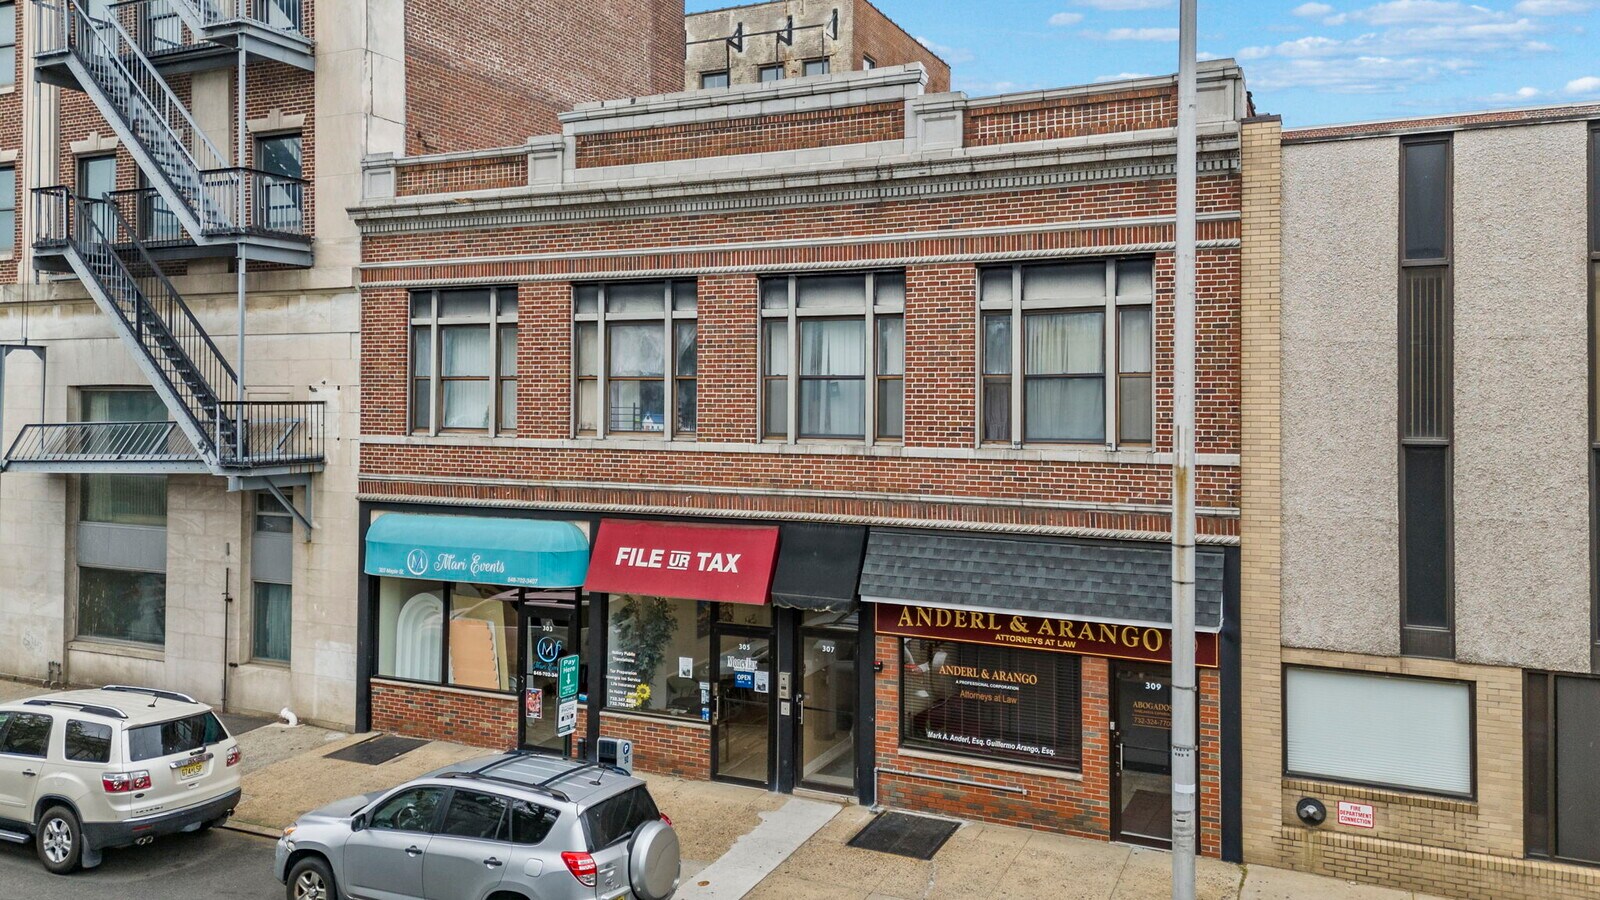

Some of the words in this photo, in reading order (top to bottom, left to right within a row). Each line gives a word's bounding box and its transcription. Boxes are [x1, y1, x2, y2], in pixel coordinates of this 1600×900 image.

[434, 553, 467, 572] Mari
[470, 553, 505, 577] Events
[615, 547, 665, 569] FILE
[668, 553, 691, 568] UR
[697, 552, 741, 573] TAX
[897, 605, 1002, 631] ANDERL
[1009, 615, 1029, 634] &
[1037, 618, 1163, 652] ARANGO
[995, 633, 1043, 645] ATTORNEYS
[1044, 638, 1056, 646] AT
[1057, 640, 1077, 649] LAW
[822, 645, 835, 653] 307
[563, 666, 576, 674] Here
[939, 665, 979, 678] ANDERL
[981, 669, 990, 679] &
[992, 670, 1038, 685] ARANGO
[959, 680, 989, 688] PROFESSIONAL
[990, 683, 1020, 691] CORPORATION
[1145, 681, 1162, 691] 309
[960, 690, 992, 703] Attorneys
[994, 694, 1002, 702] at
[1002, 694, 1018, 705] Law
[927, 731, 942, 740] Mark
[943, 733, 949, 741] A.
[950, 734, 971, 744] Anderl,
[972, 737, 985, 747] Esq.
[986, 739, 1016, 750] Guillermo
[1016, 743, 1041, 754] Arango,
[1041, 746, 1056, 757] Esq.
[1340, 809, 1372, 819] DEPARTMENT
[1340, 815, 1371, 825] CONNECTION
